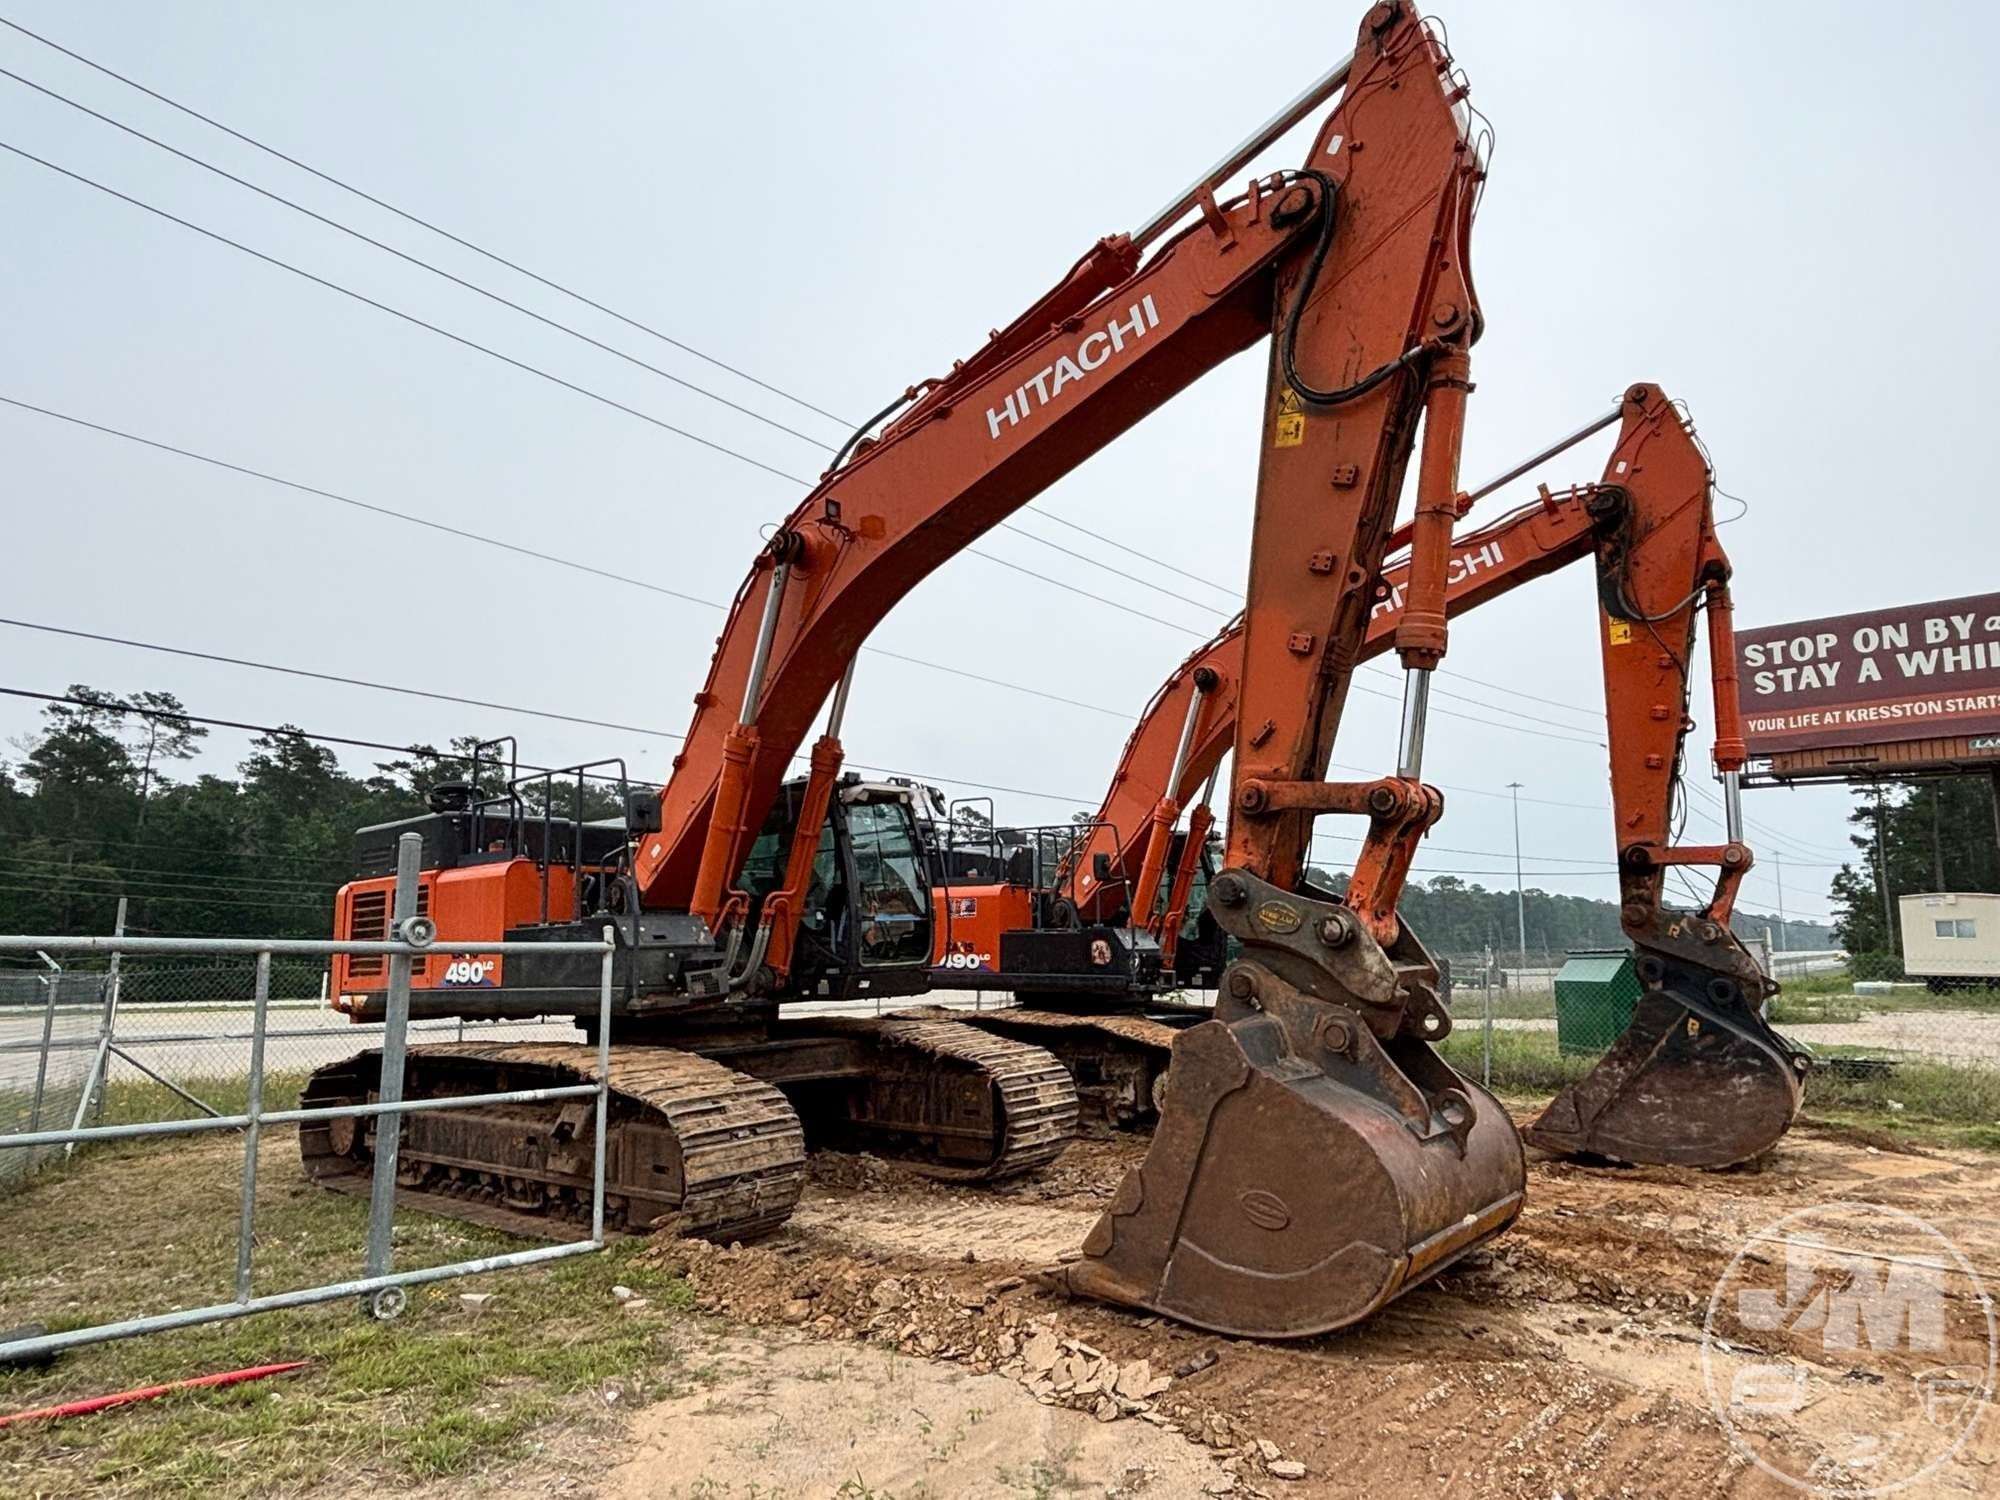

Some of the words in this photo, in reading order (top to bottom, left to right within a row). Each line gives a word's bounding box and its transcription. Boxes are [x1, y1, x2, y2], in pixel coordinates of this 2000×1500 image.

[985, 294, 1160, 440] HITACHI
[1744, 633, 1838, 667] STOP
[1853, 622, 1909, 653] ON
[1924, 613, 1976, 644] BY
[1754, 661, 1841, 695] STAY
[1857, 657, 1882, 683] A
[1748, 717, 1786, 732] YOUR
[1789, 713, 1821, 728] LIFE
[1823, 711, 1842, 724] AT
[1846, 700, 1943, 723] KRESSTON
[1945, 694, 2000, 712] START
[445, 961, 484, 984] 490
